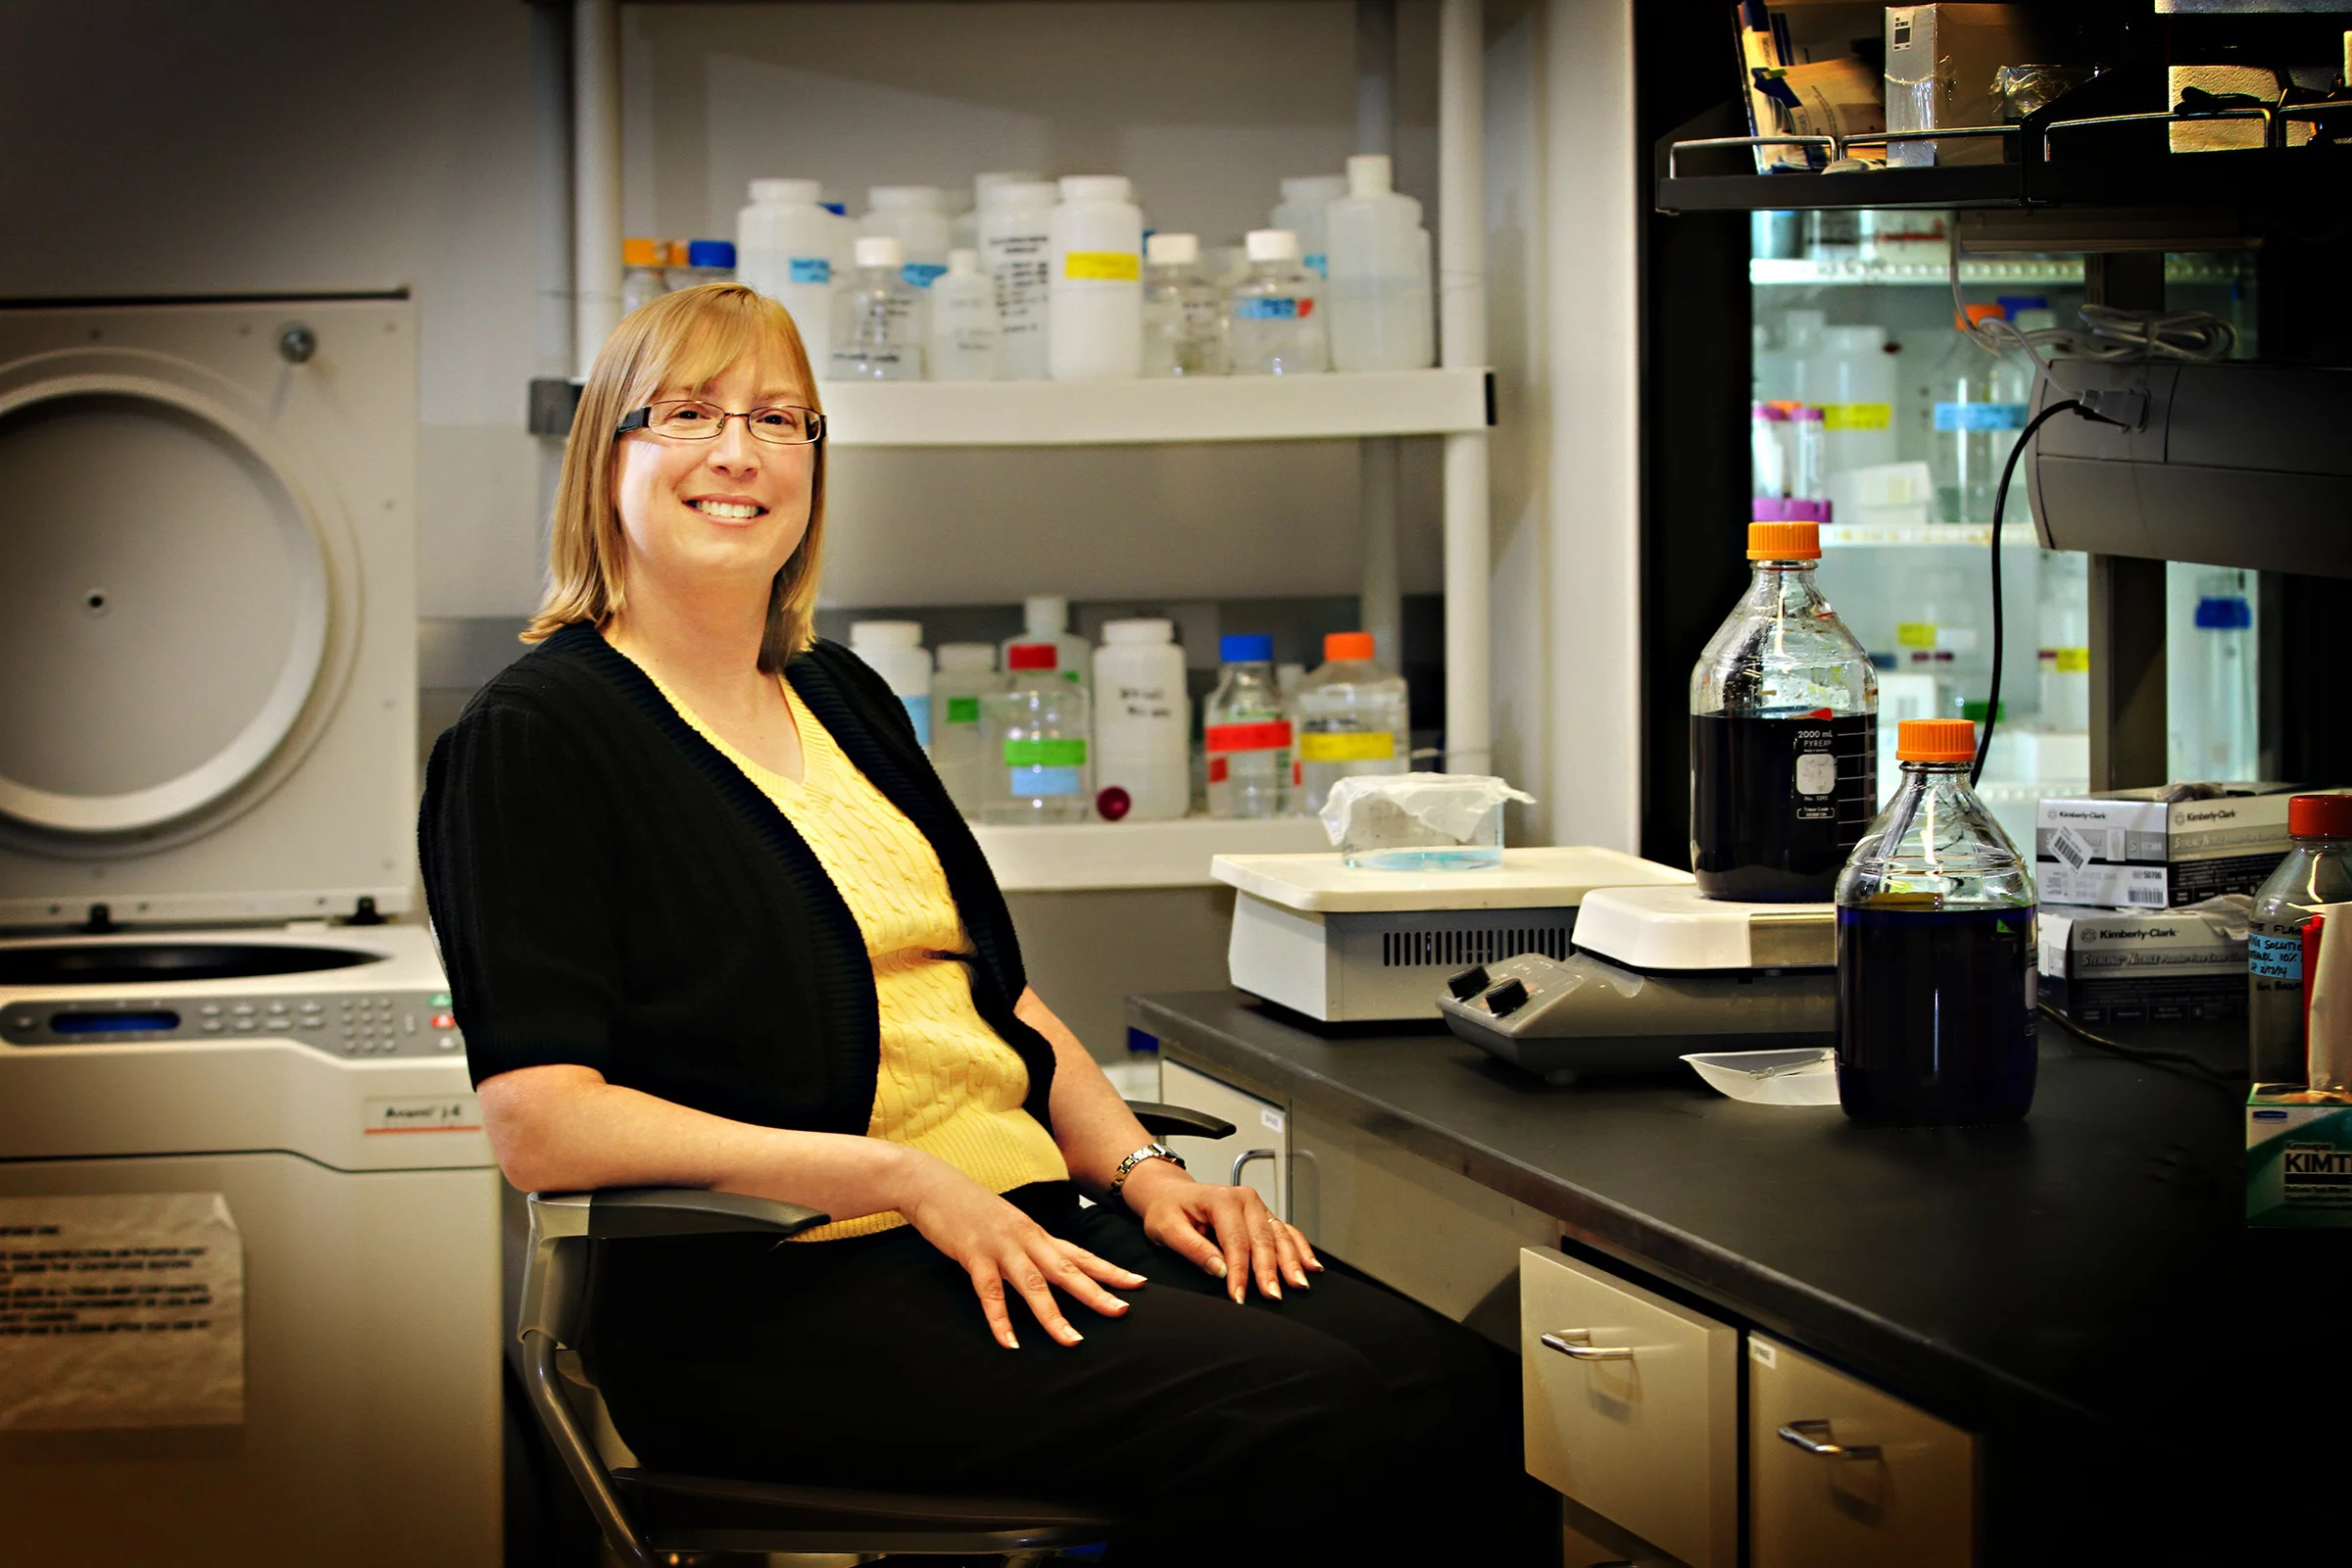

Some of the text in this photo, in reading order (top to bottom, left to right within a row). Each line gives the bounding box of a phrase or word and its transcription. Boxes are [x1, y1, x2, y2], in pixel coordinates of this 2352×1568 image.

[2186, 809, 2236, 821] Kimberly-Clark
[2099, 928, 2178, 941] Kimberly-Clark
[2284, 1152, 2352, 1173] KIMT
